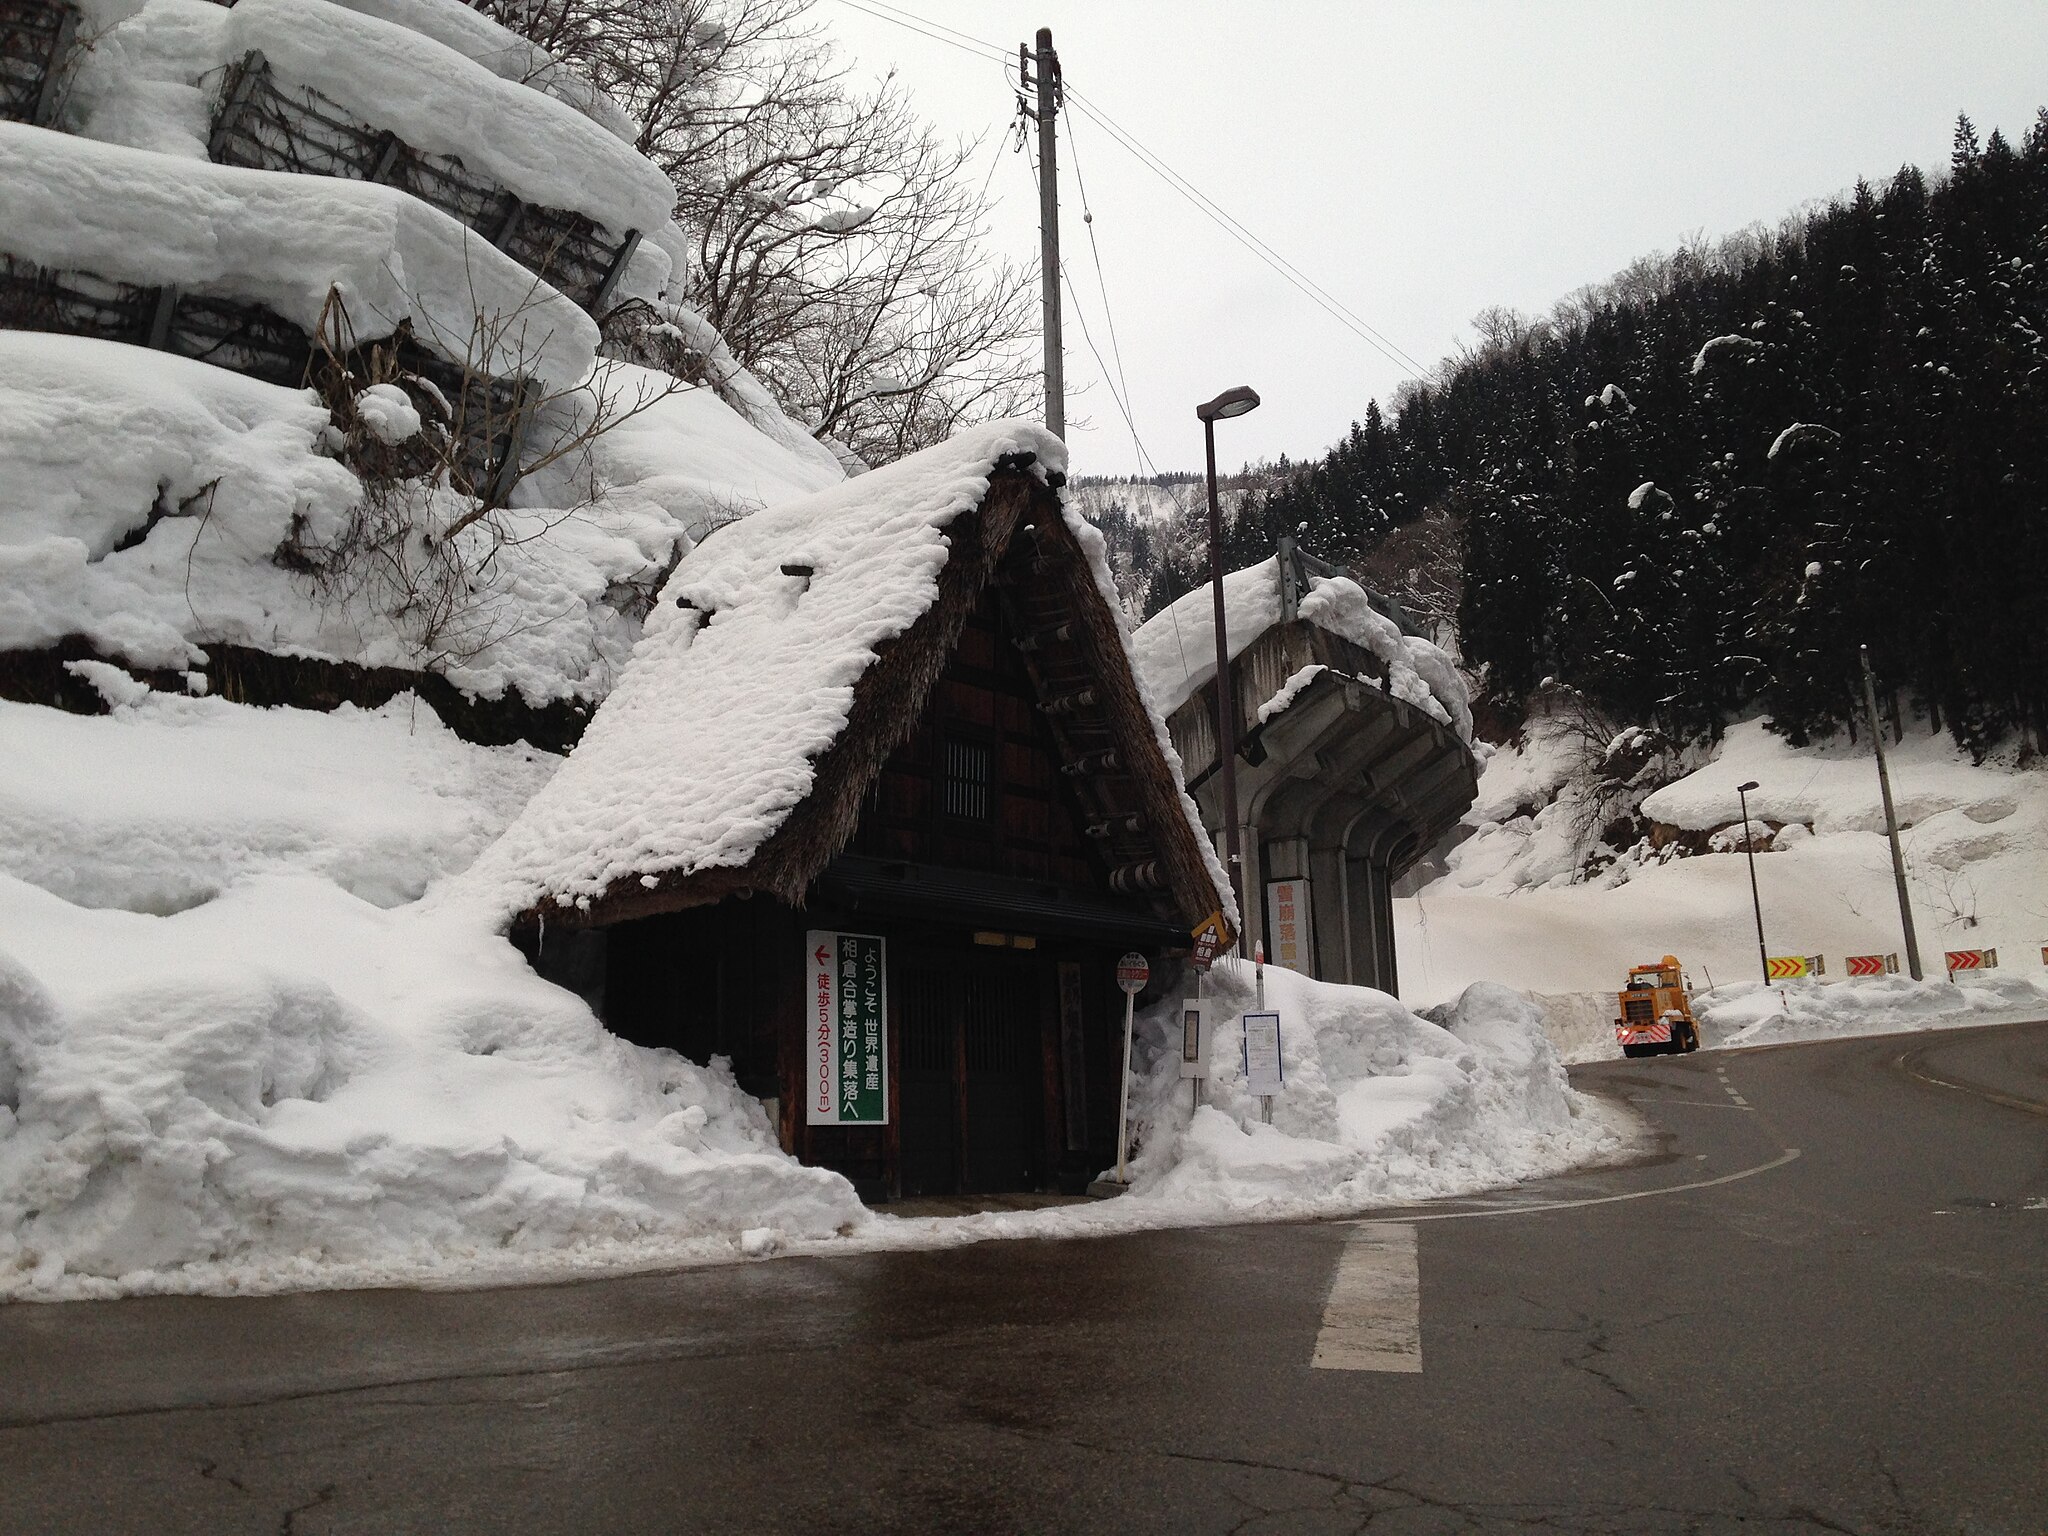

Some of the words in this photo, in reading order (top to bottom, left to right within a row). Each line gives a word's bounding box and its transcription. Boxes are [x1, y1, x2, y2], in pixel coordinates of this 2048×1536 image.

[864, 948, 878, 1013] ようこそ
[841, 938, 859, 1119] 相倉合掌造り集落へ
[864, 1019, 879, 1090] 世界遺産
